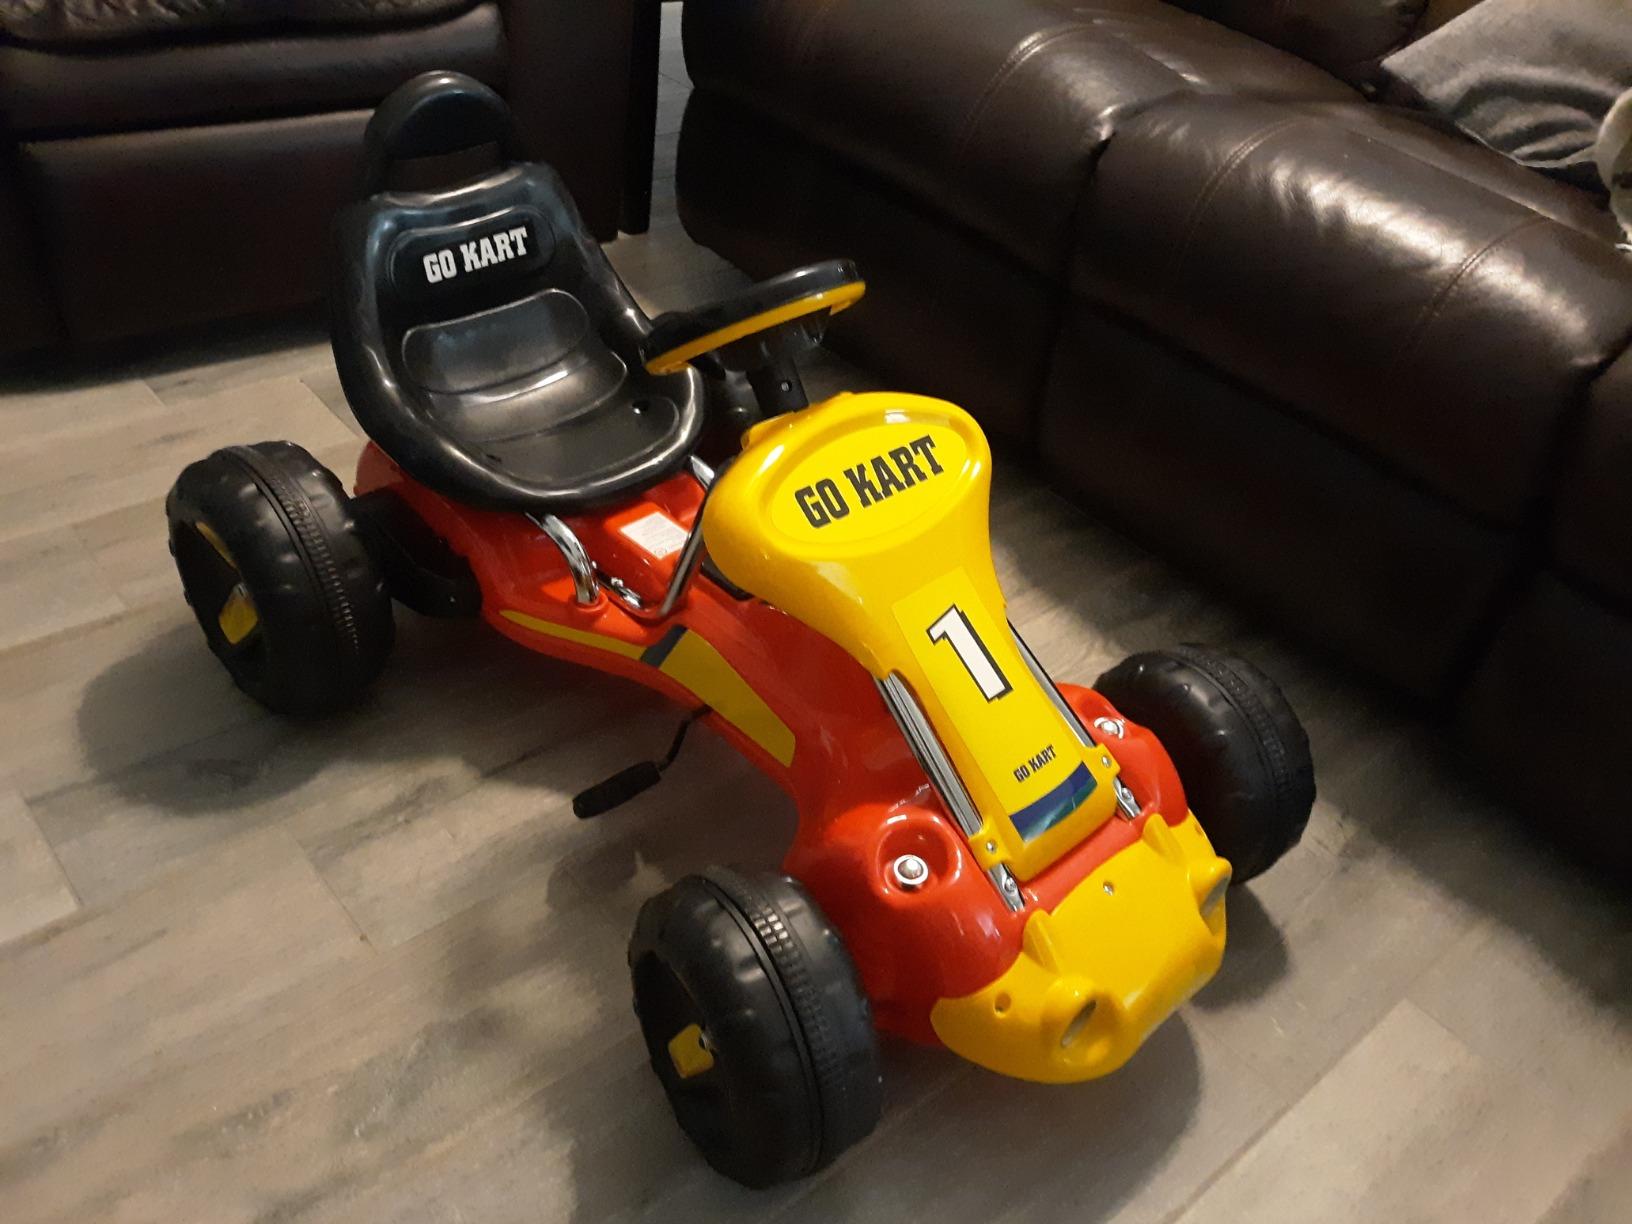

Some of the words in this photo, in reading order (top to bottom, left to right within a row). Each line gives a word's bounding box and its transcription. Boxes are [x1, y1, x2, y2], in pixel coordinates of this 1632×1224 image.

[422, 249, 457, 284] GO
[459, 226, 528, 273] KART
[794, 478, 850, 529] GO
[843, 434, 944, 508] KART
[926, 603, 1014, 704] 1
[1013, 764, 1030, 782] GO
[1028, 744, 1056, 772] KART
